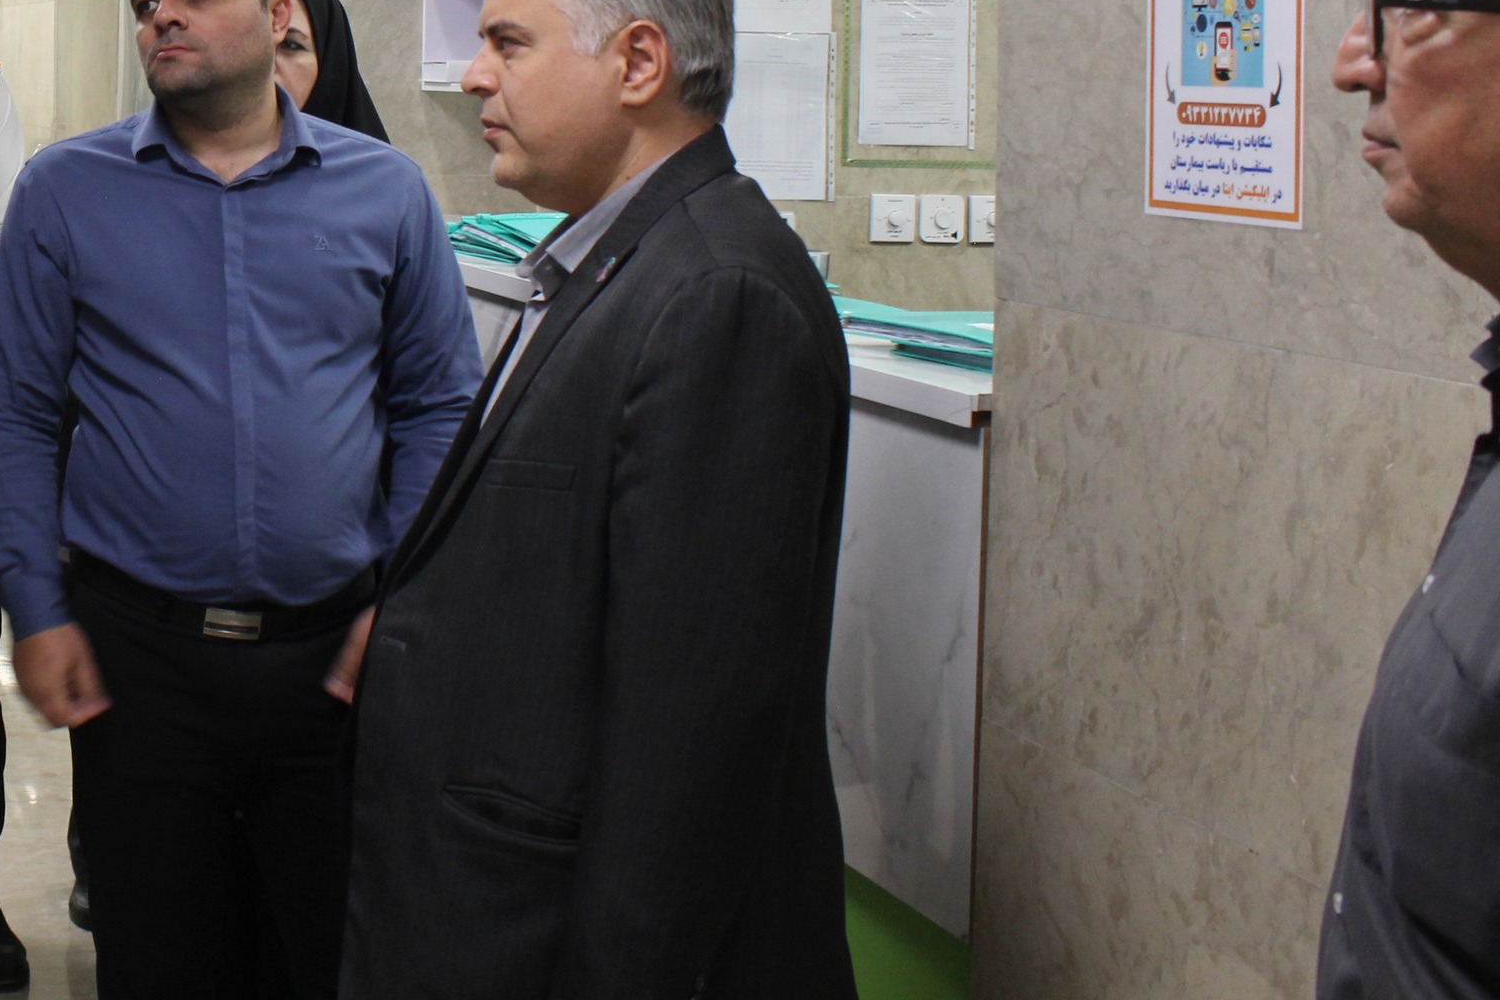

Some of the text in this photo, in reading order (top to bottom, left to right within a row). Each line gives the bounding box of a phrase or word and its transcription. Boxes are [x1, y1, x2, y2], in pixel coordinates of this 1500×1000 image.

[1173, 131, 1272, 151] شکایات و پیشنهادات خود را
[1171, 155, 1204, 172] بیمارستان
[1206, 157, 1231, 175] ریاست
[1232, 159, 1238, 174] با
[1164, 178, 1191, 195] بگذارید
[1193, 180, 1209, 196] میان
[1212, 185, 1221, 198] در
[1272, 189, 1282, 203] در
